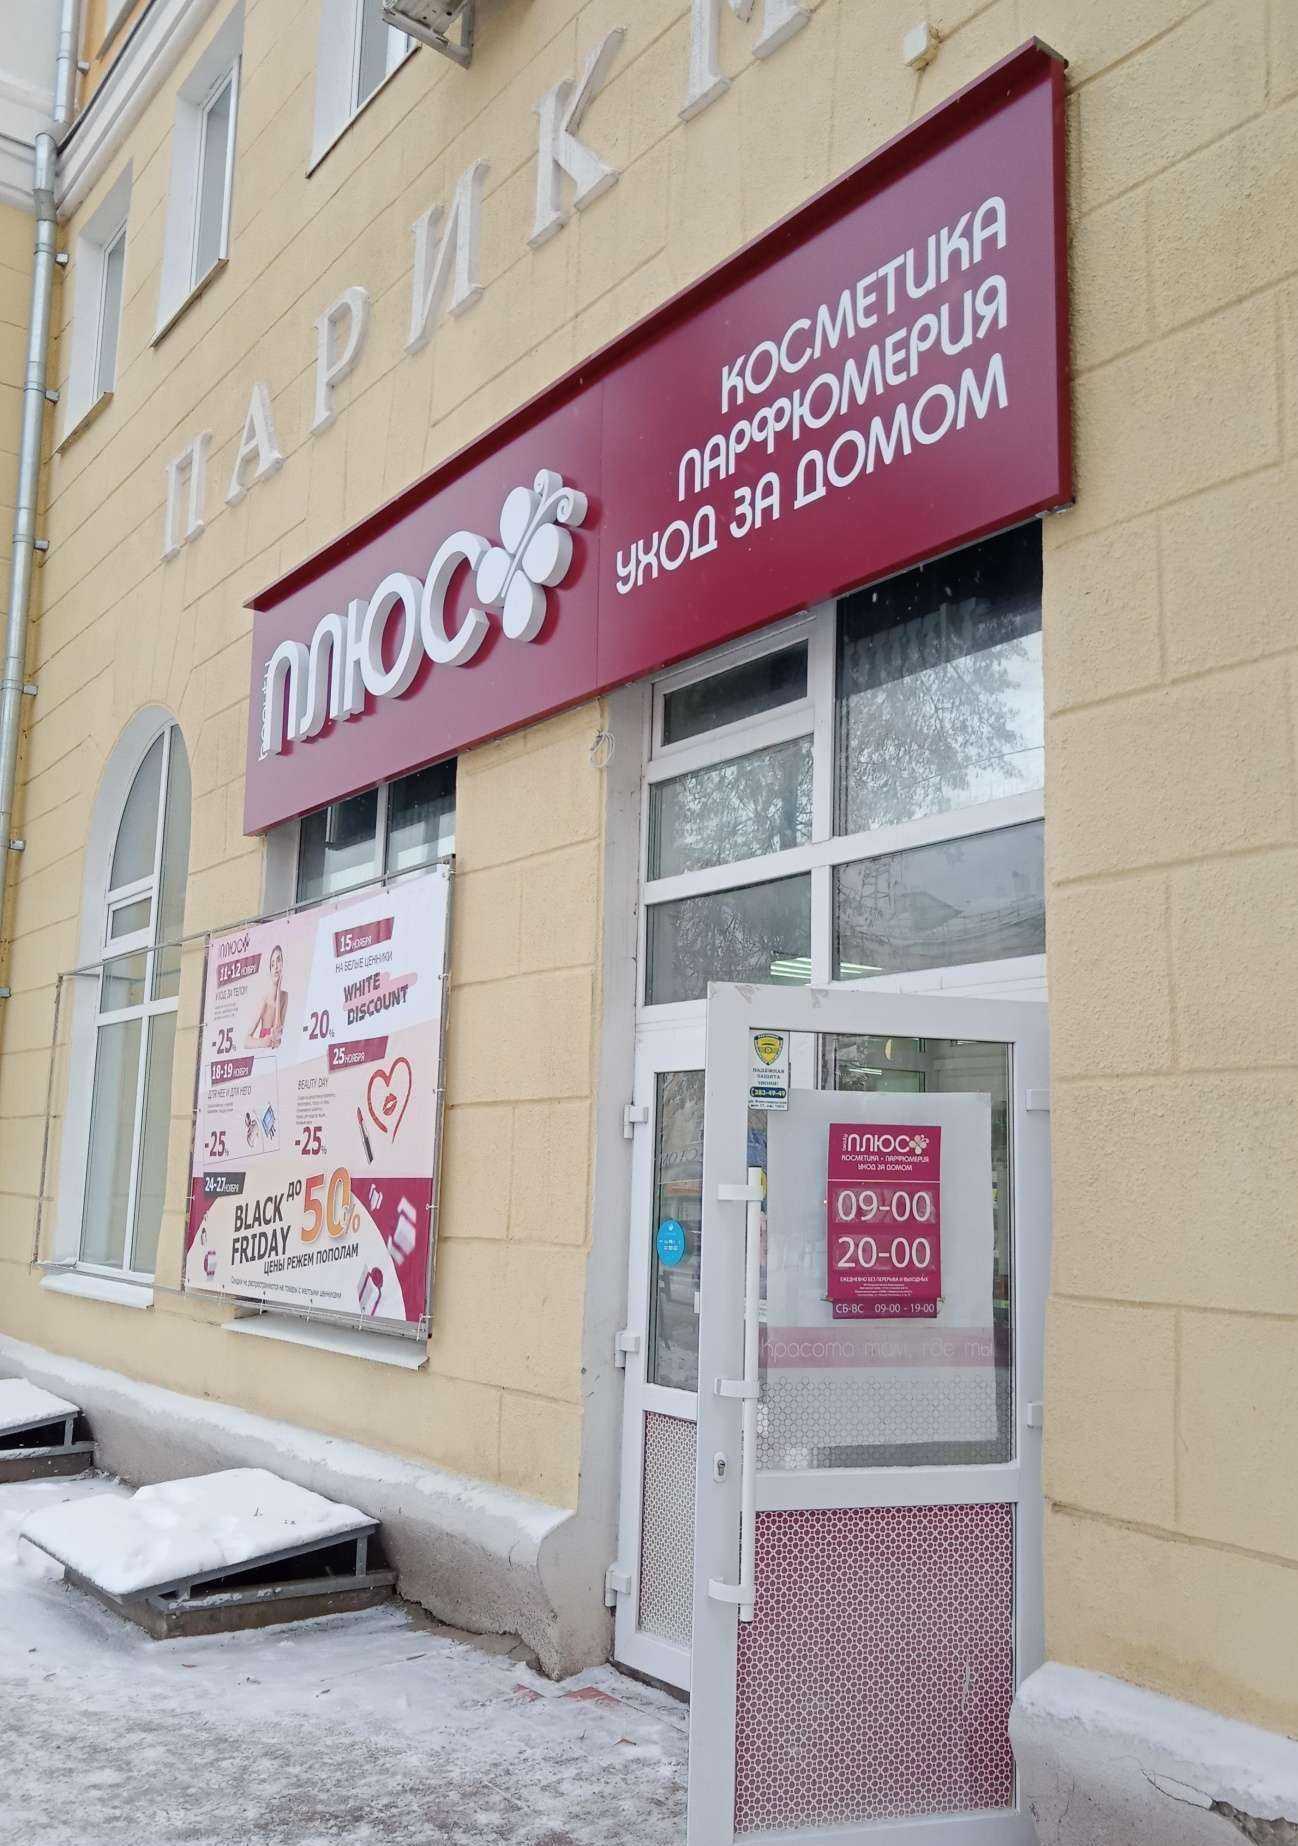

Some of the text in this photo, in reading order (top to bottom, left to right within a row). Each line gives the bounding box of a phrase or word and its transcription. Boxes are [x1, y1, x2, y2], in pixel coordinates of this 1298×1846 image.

[721, 195, 1007, 414] КОСМЕТИКА
[678, 274, 1008, 502] ПАРФЮМЕРИЯ
[615, 352, 1008, 594] УХОД ЗА ДОМОМ
[263, 530, 493, 756] ПЛЮС
[340, 934, 352, 951] 15
[219, 963, 241, 981] 11-12
[343, 972, 381, 1003] WHITE
[347, 984, 409, 1025] DISCOUNT
[212, 1063, 233, 1080] 18-19
[333, 1048, 345, 1065] 25
[841, 1154, 879, 1162] КОСМЕТИКА
[847, 1133, 910, 1153] ПЛЮС
[205, 1177, 226, 1192] 24-27
[234, 1193, 285, 1233] BLACK
[837, 1190, 931, 1222] 09-00
[231, 1225, 291, 1266] FRIDAY
[263, 1243, 359, 1276] ЦЕНЫ РЕЖЕМ ПОПОЛАМ
[837, 1237, 931, 1268] 20-00
[835, 1303, 865, 1313] СБ-ВС
[874, 1303, 901, 1313] 09-00
[910, 1303, 935, 1313] 19-00
